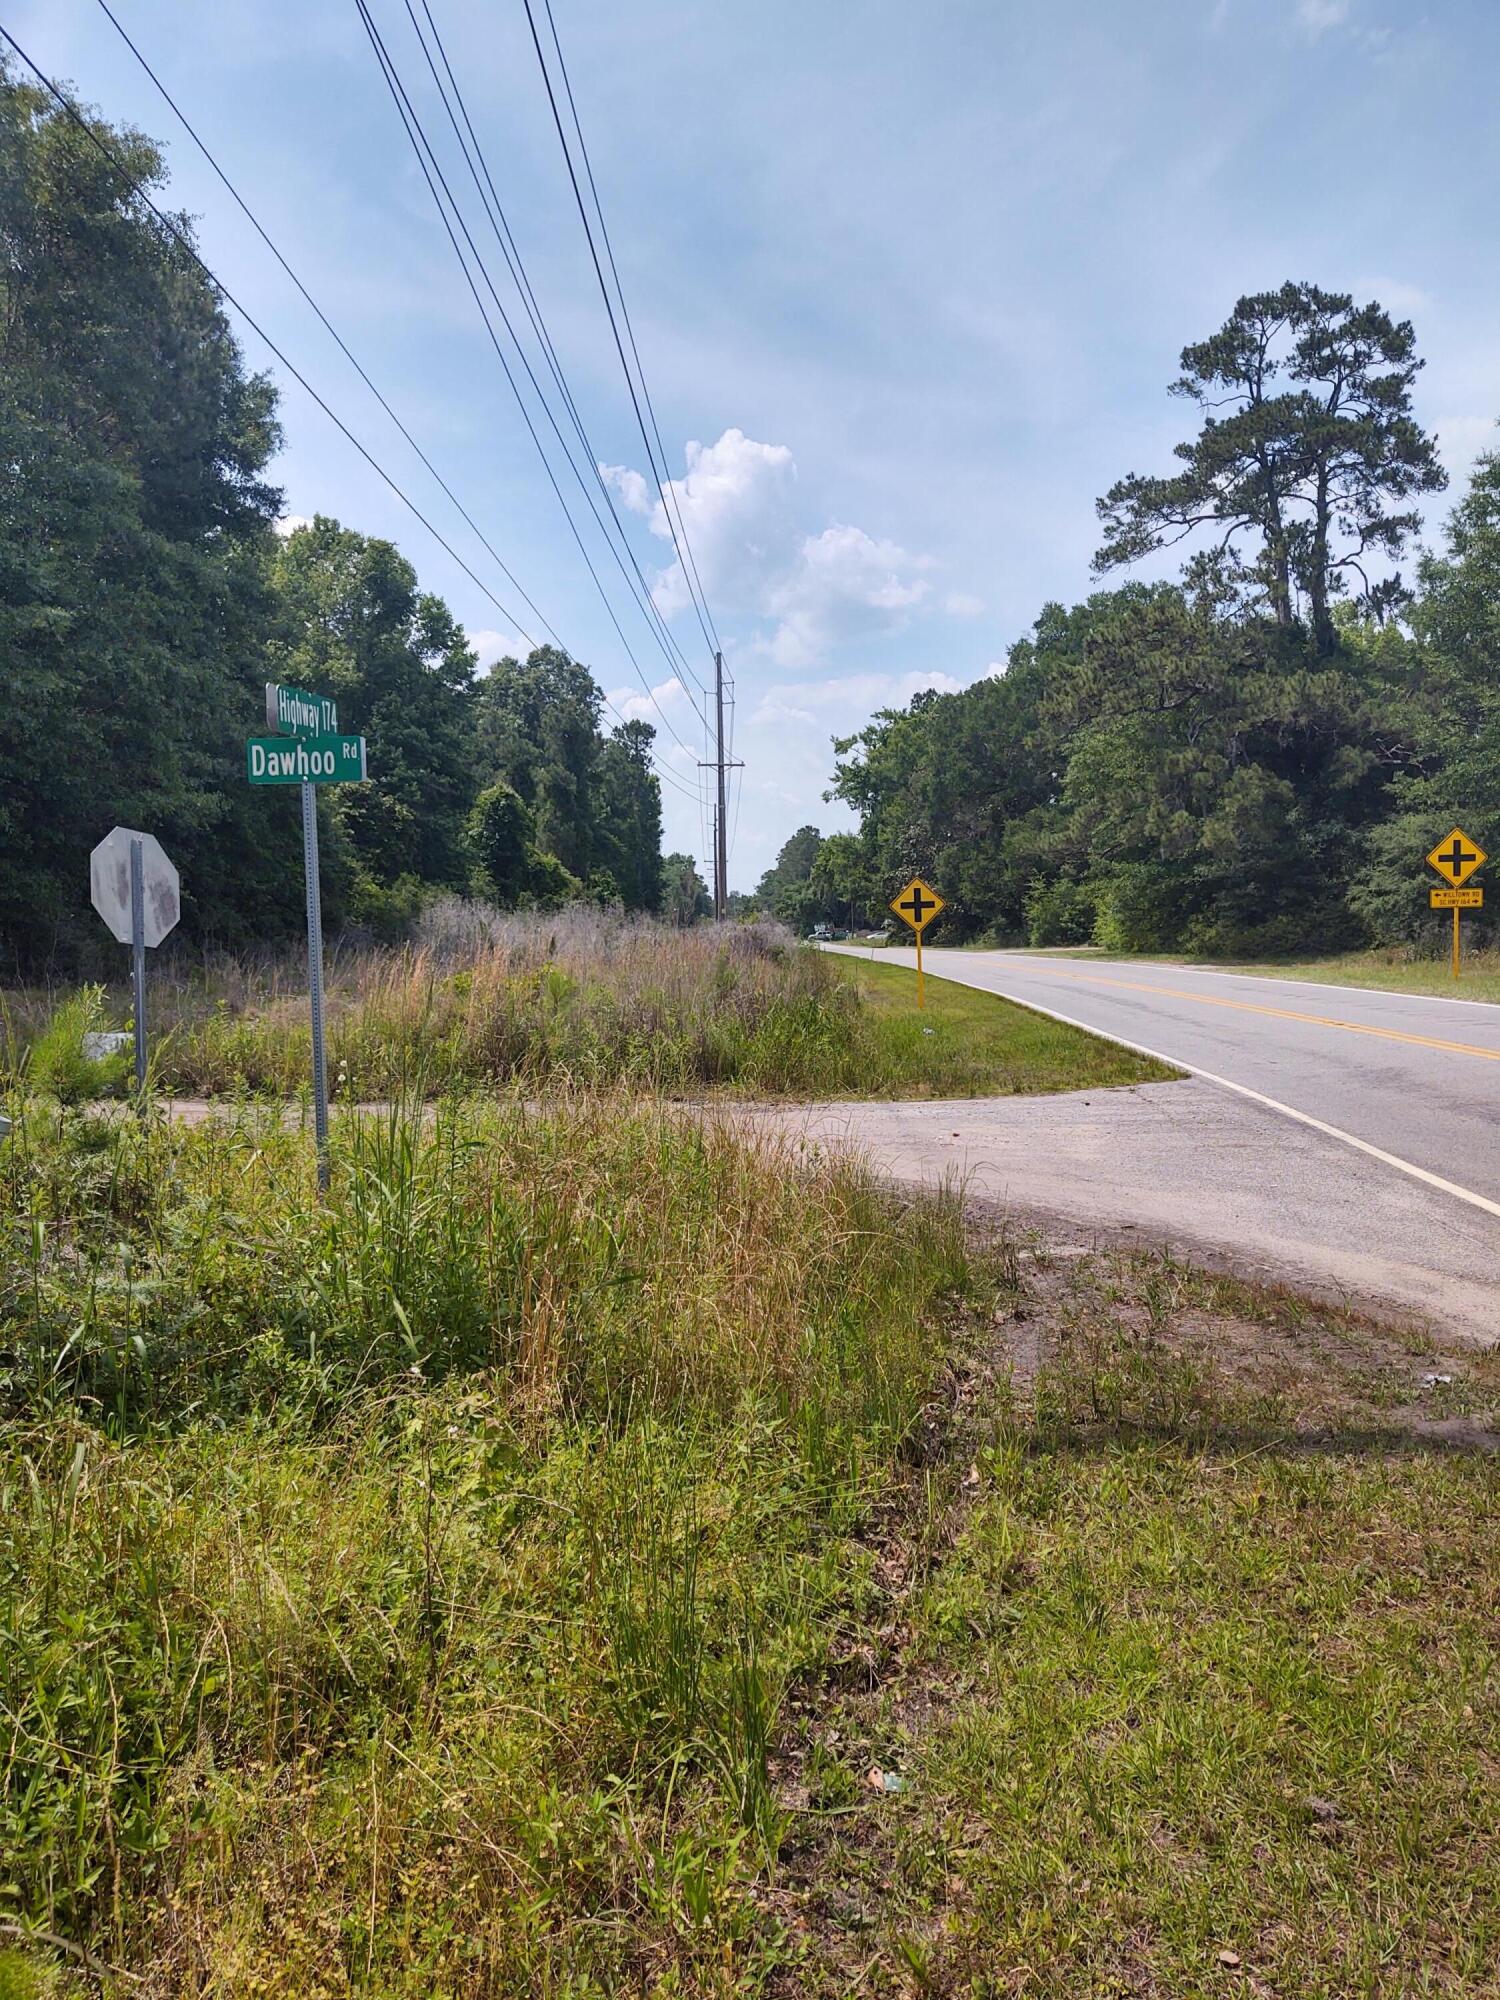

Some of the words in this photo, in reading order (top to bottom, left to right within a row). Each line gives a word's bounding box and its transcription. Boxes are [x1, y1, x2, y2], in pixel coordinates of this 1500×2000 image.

[279, 689, 319, 737] Highway
[321, 700, 338, 733] 174
[251, 744, 335, 776] Dawhoo
